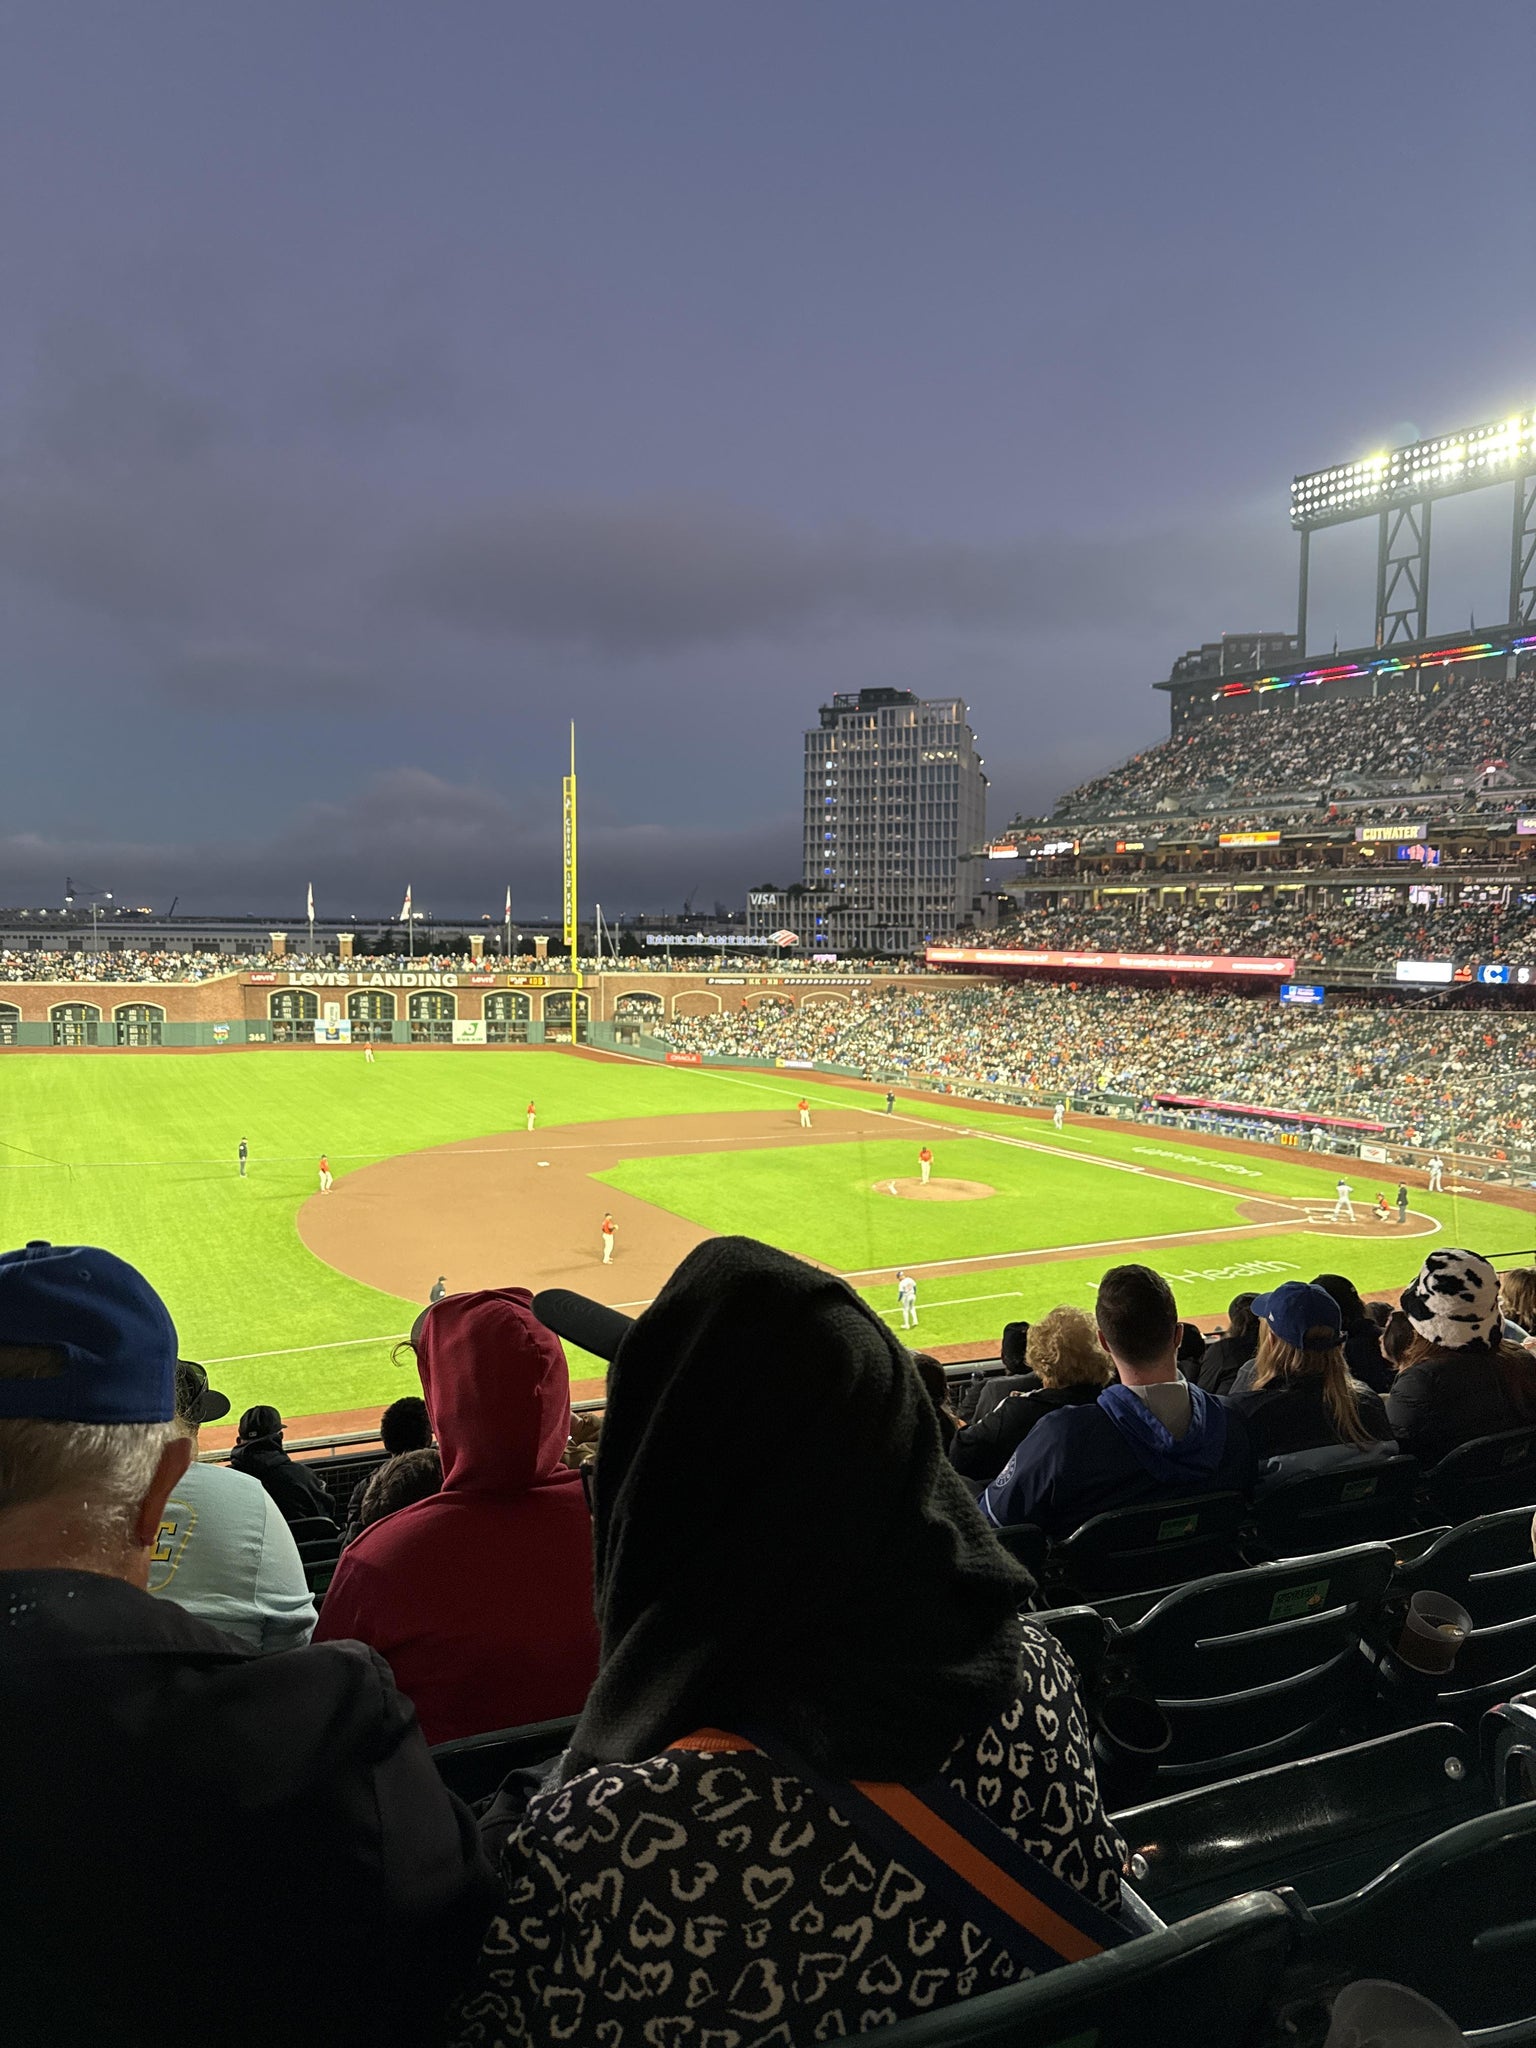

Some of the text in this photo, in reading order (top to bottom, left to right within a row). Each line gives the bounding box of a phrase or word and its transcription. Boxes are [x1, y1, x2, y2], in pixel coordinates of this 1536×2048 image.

[1363, 826, 1418, 841] CUTWATER
[751, 894, 776, 905] VISA
[646, 935, 768, 945] BANK OF AMERICA
[356, 973, 458, 987] LANDING
[670, 1054, 697, 1062] ORACLE
[1163, 1260, 1301, 1283] Health
